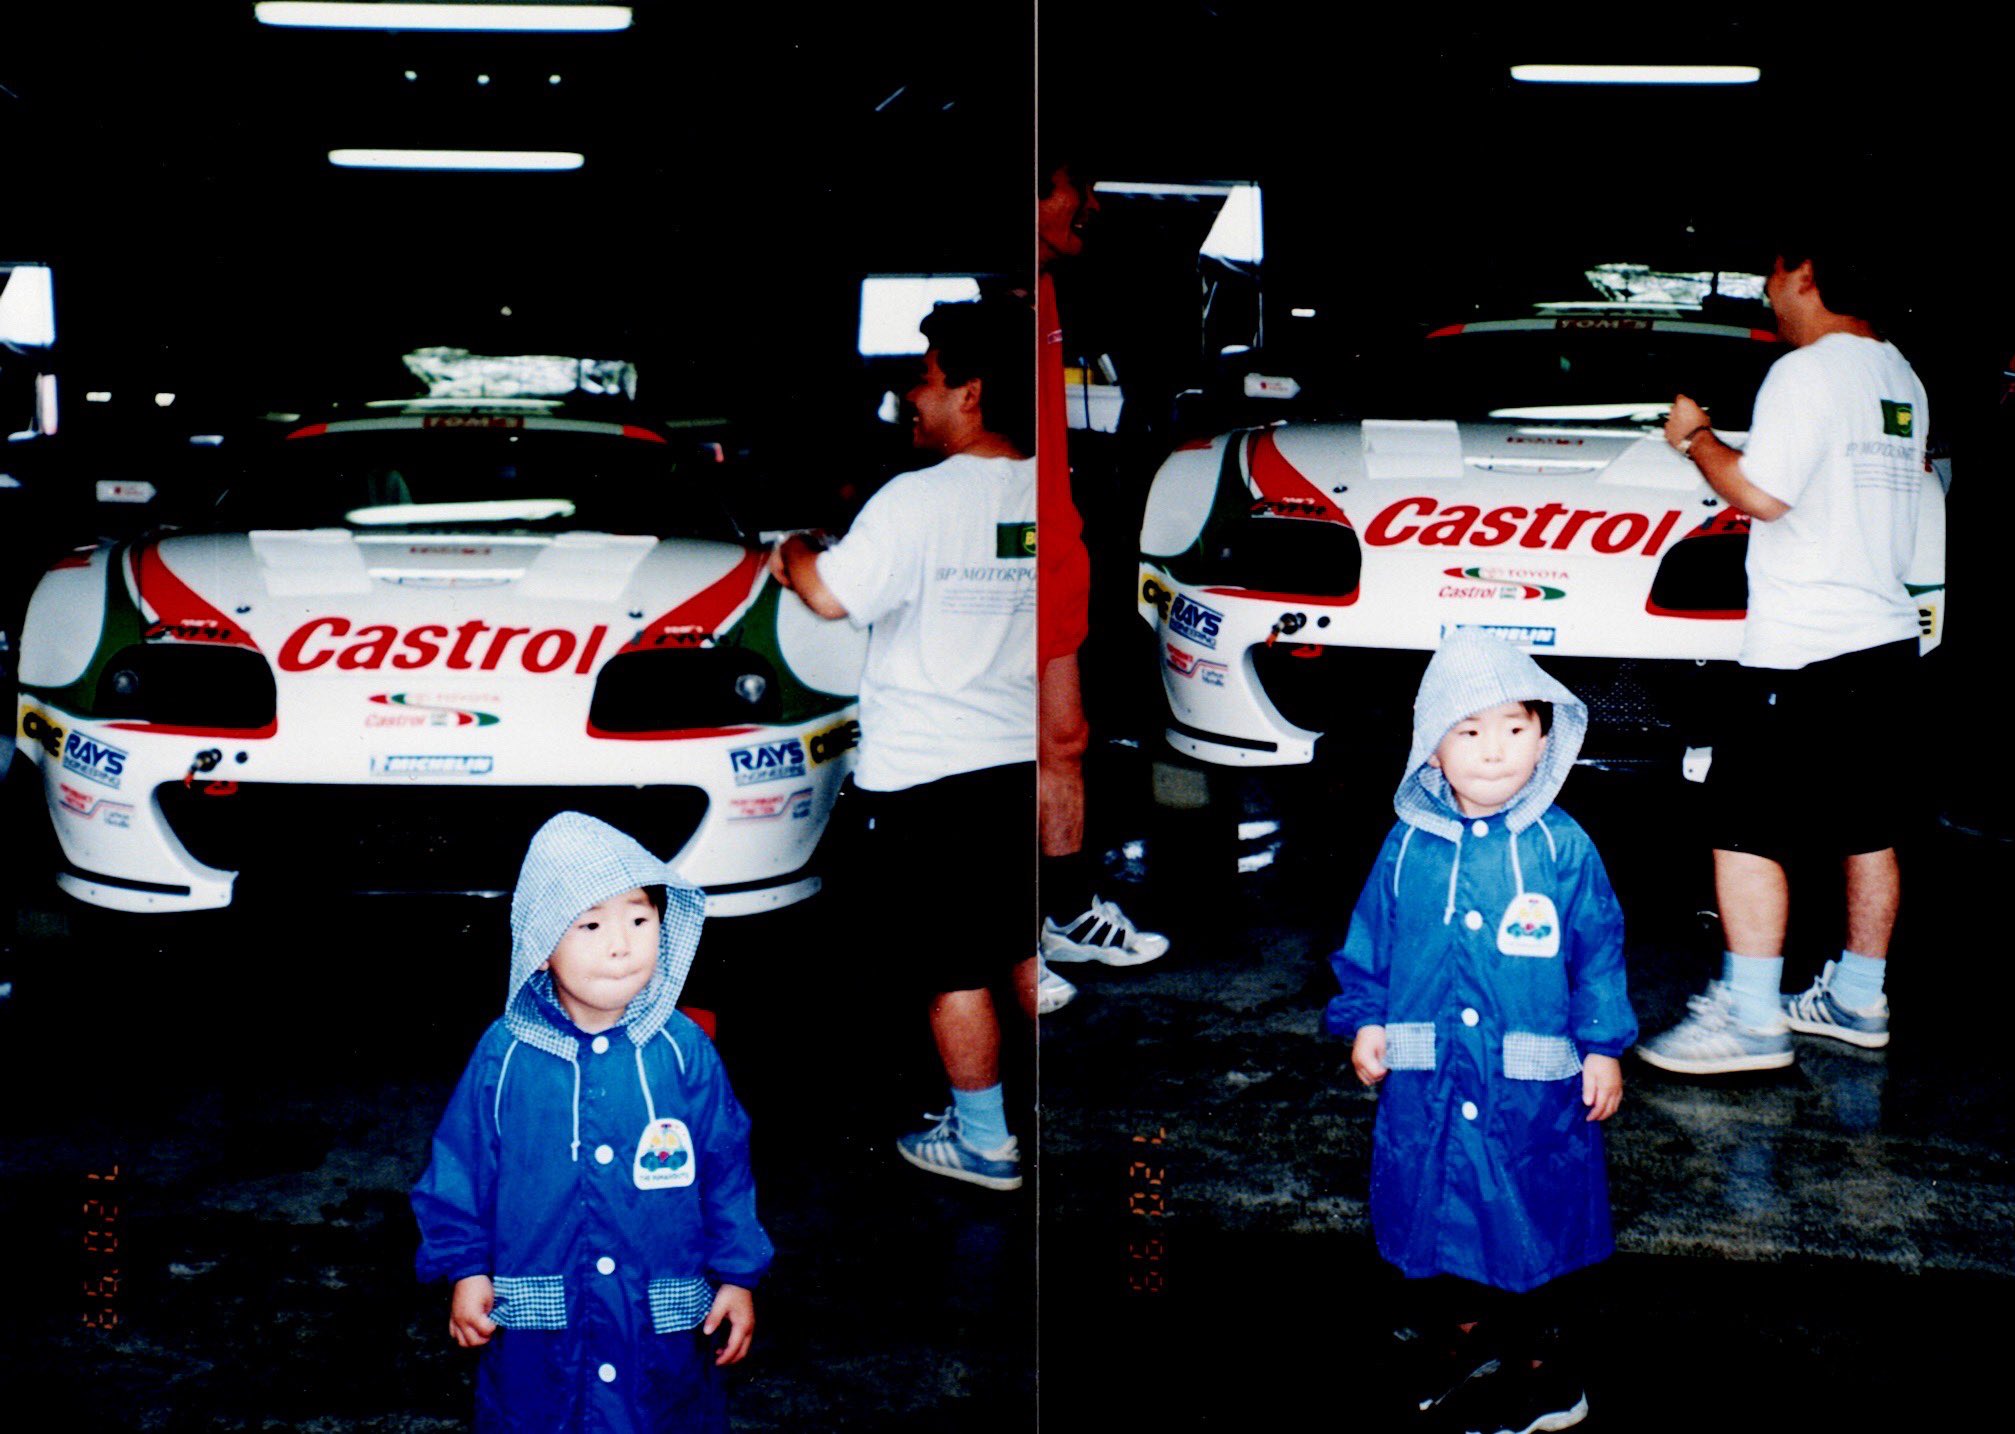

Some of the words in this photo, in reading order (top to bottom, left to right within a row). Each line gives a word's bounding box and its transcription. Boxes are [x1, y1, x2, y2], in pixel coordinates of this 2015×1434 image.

[1364, 497, 1681, 556] Castrol
[1437, 585, 1498, 599] Castrol
[1507, 569, 1570, 580] TOYOTA
[1171, 596, 1222, 637] RAYS
[278, 617, 607, 675] Castrol
[65, 733, 126, 776] RAYS
[730, 741, 805, 773] RAYS
